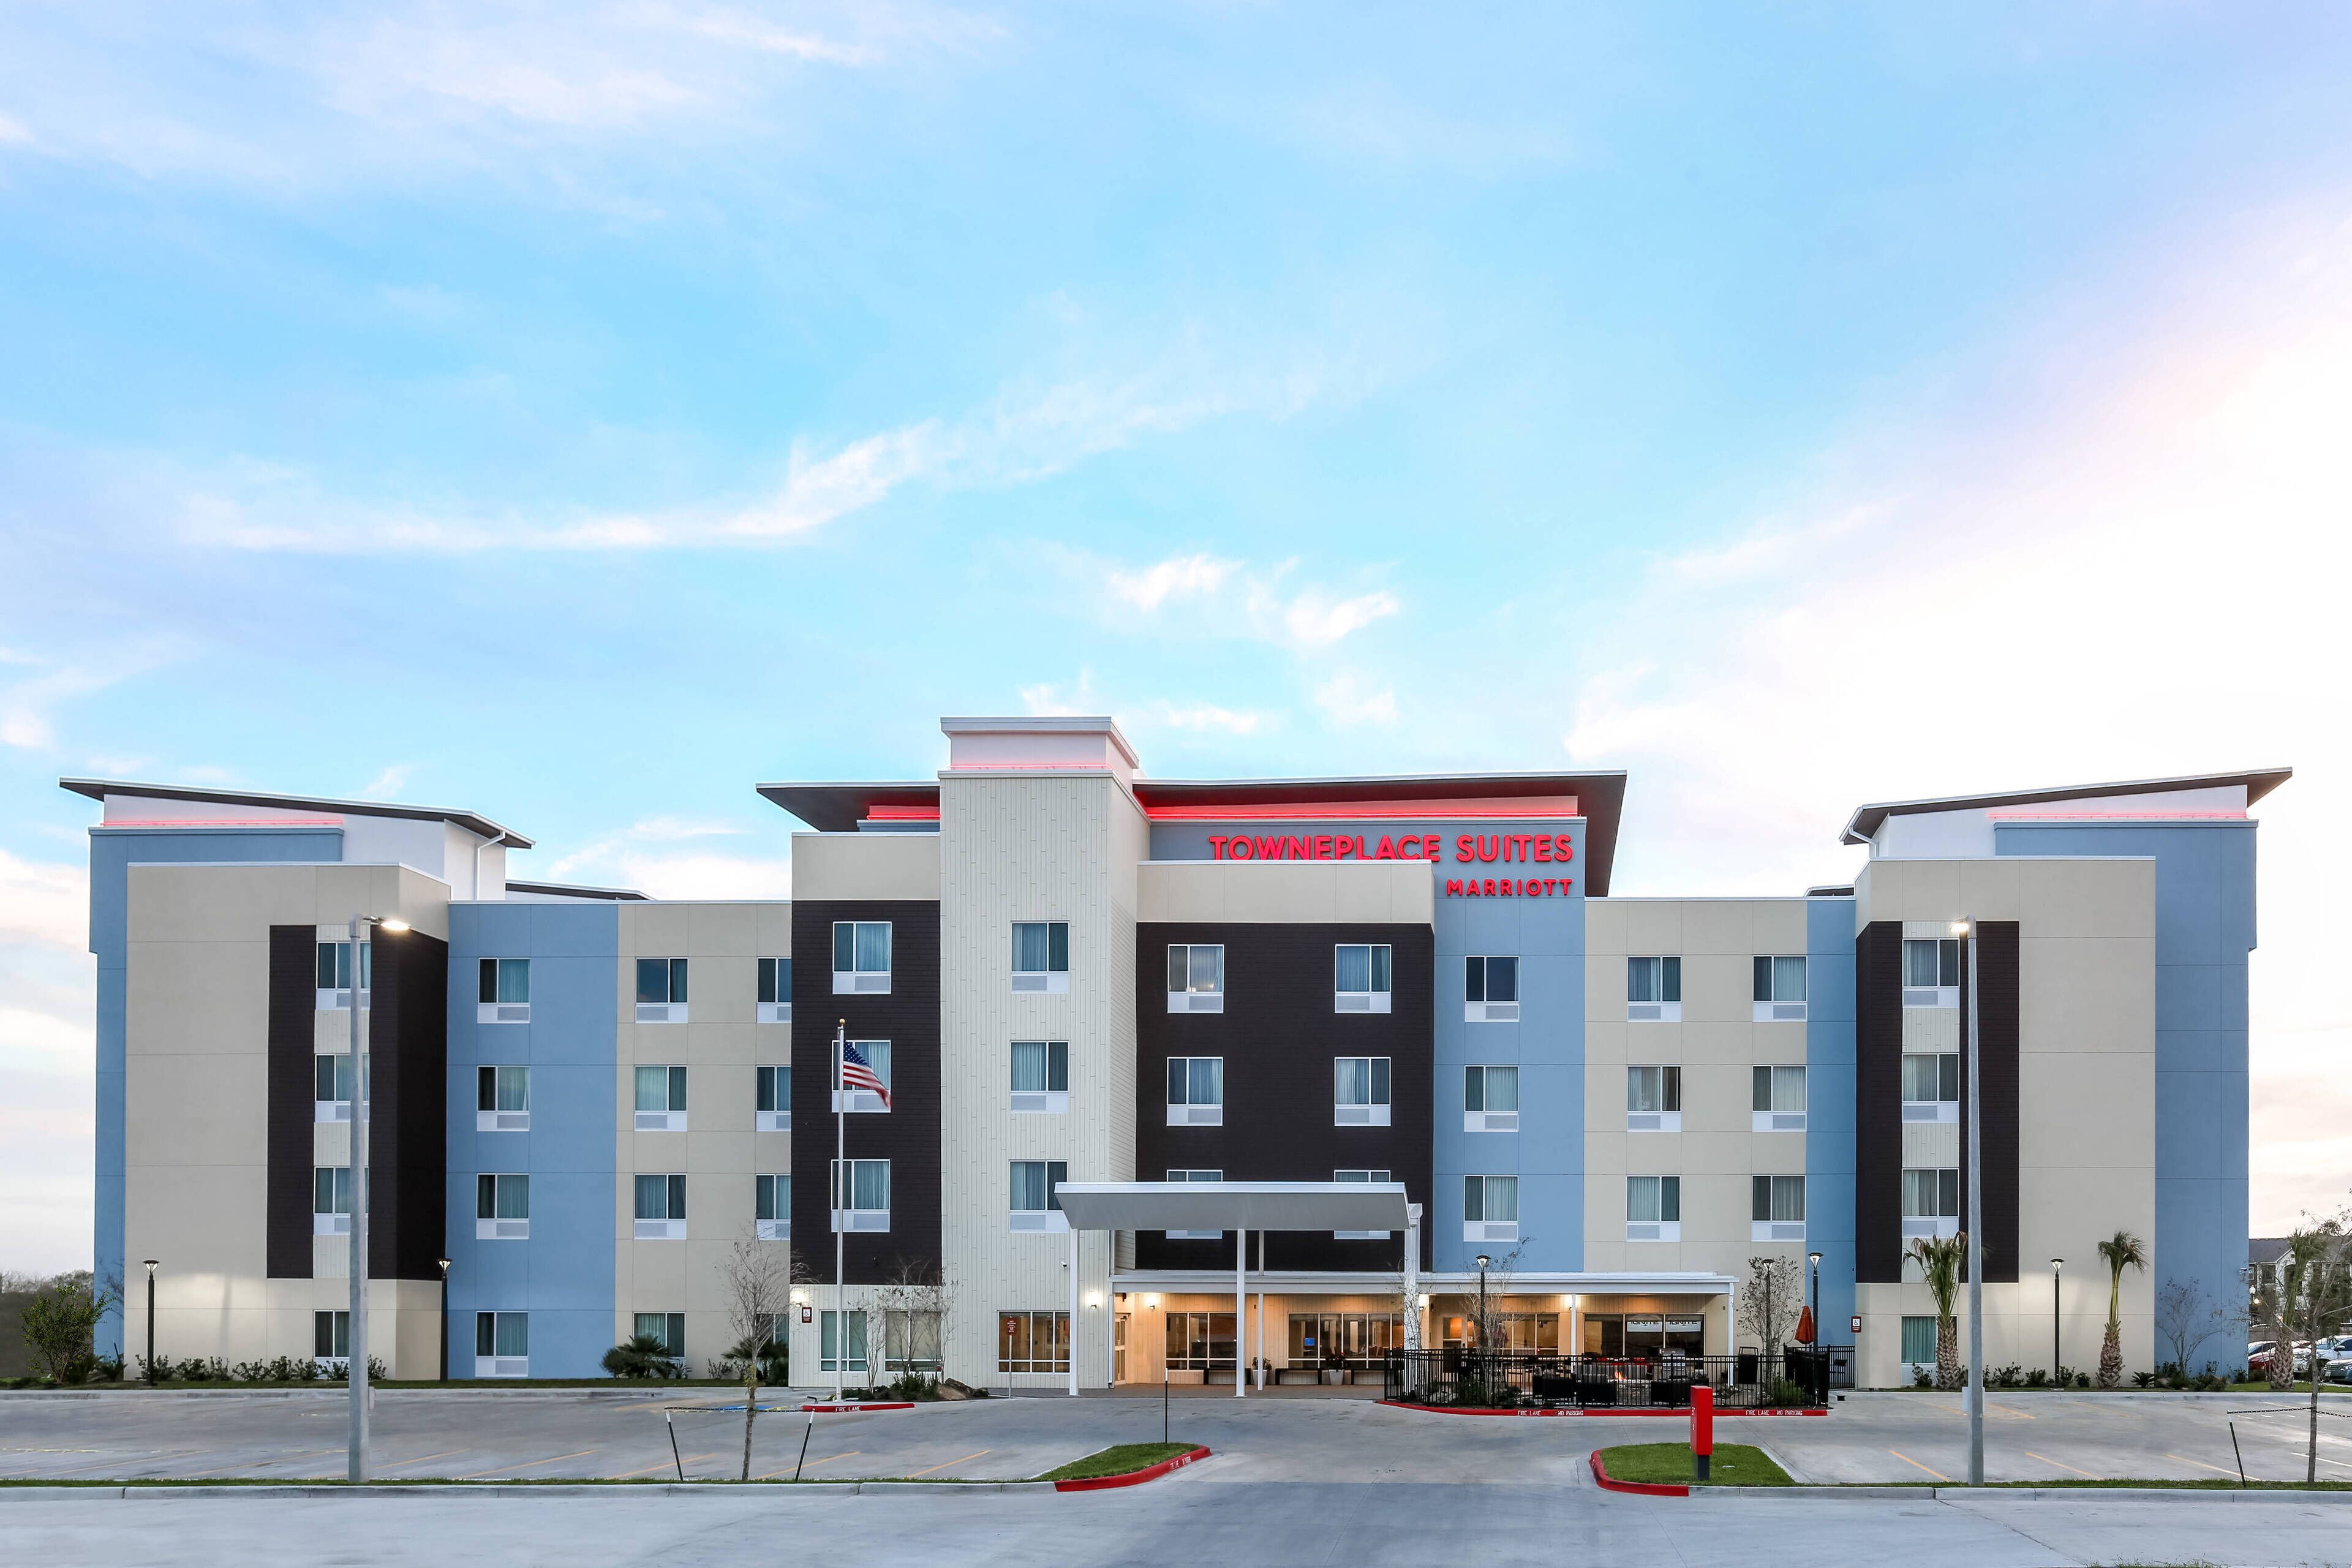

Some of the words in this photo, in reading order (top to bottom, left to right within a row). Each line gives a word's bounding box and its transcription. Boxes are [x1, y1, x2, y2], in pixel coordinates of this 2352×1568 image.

[1208, 835, 1441, 862] TOWNEPLACE
[1456, 834, 1573, 862] SUITES
[1447, 879, 1572, 895] MARRIOTT
